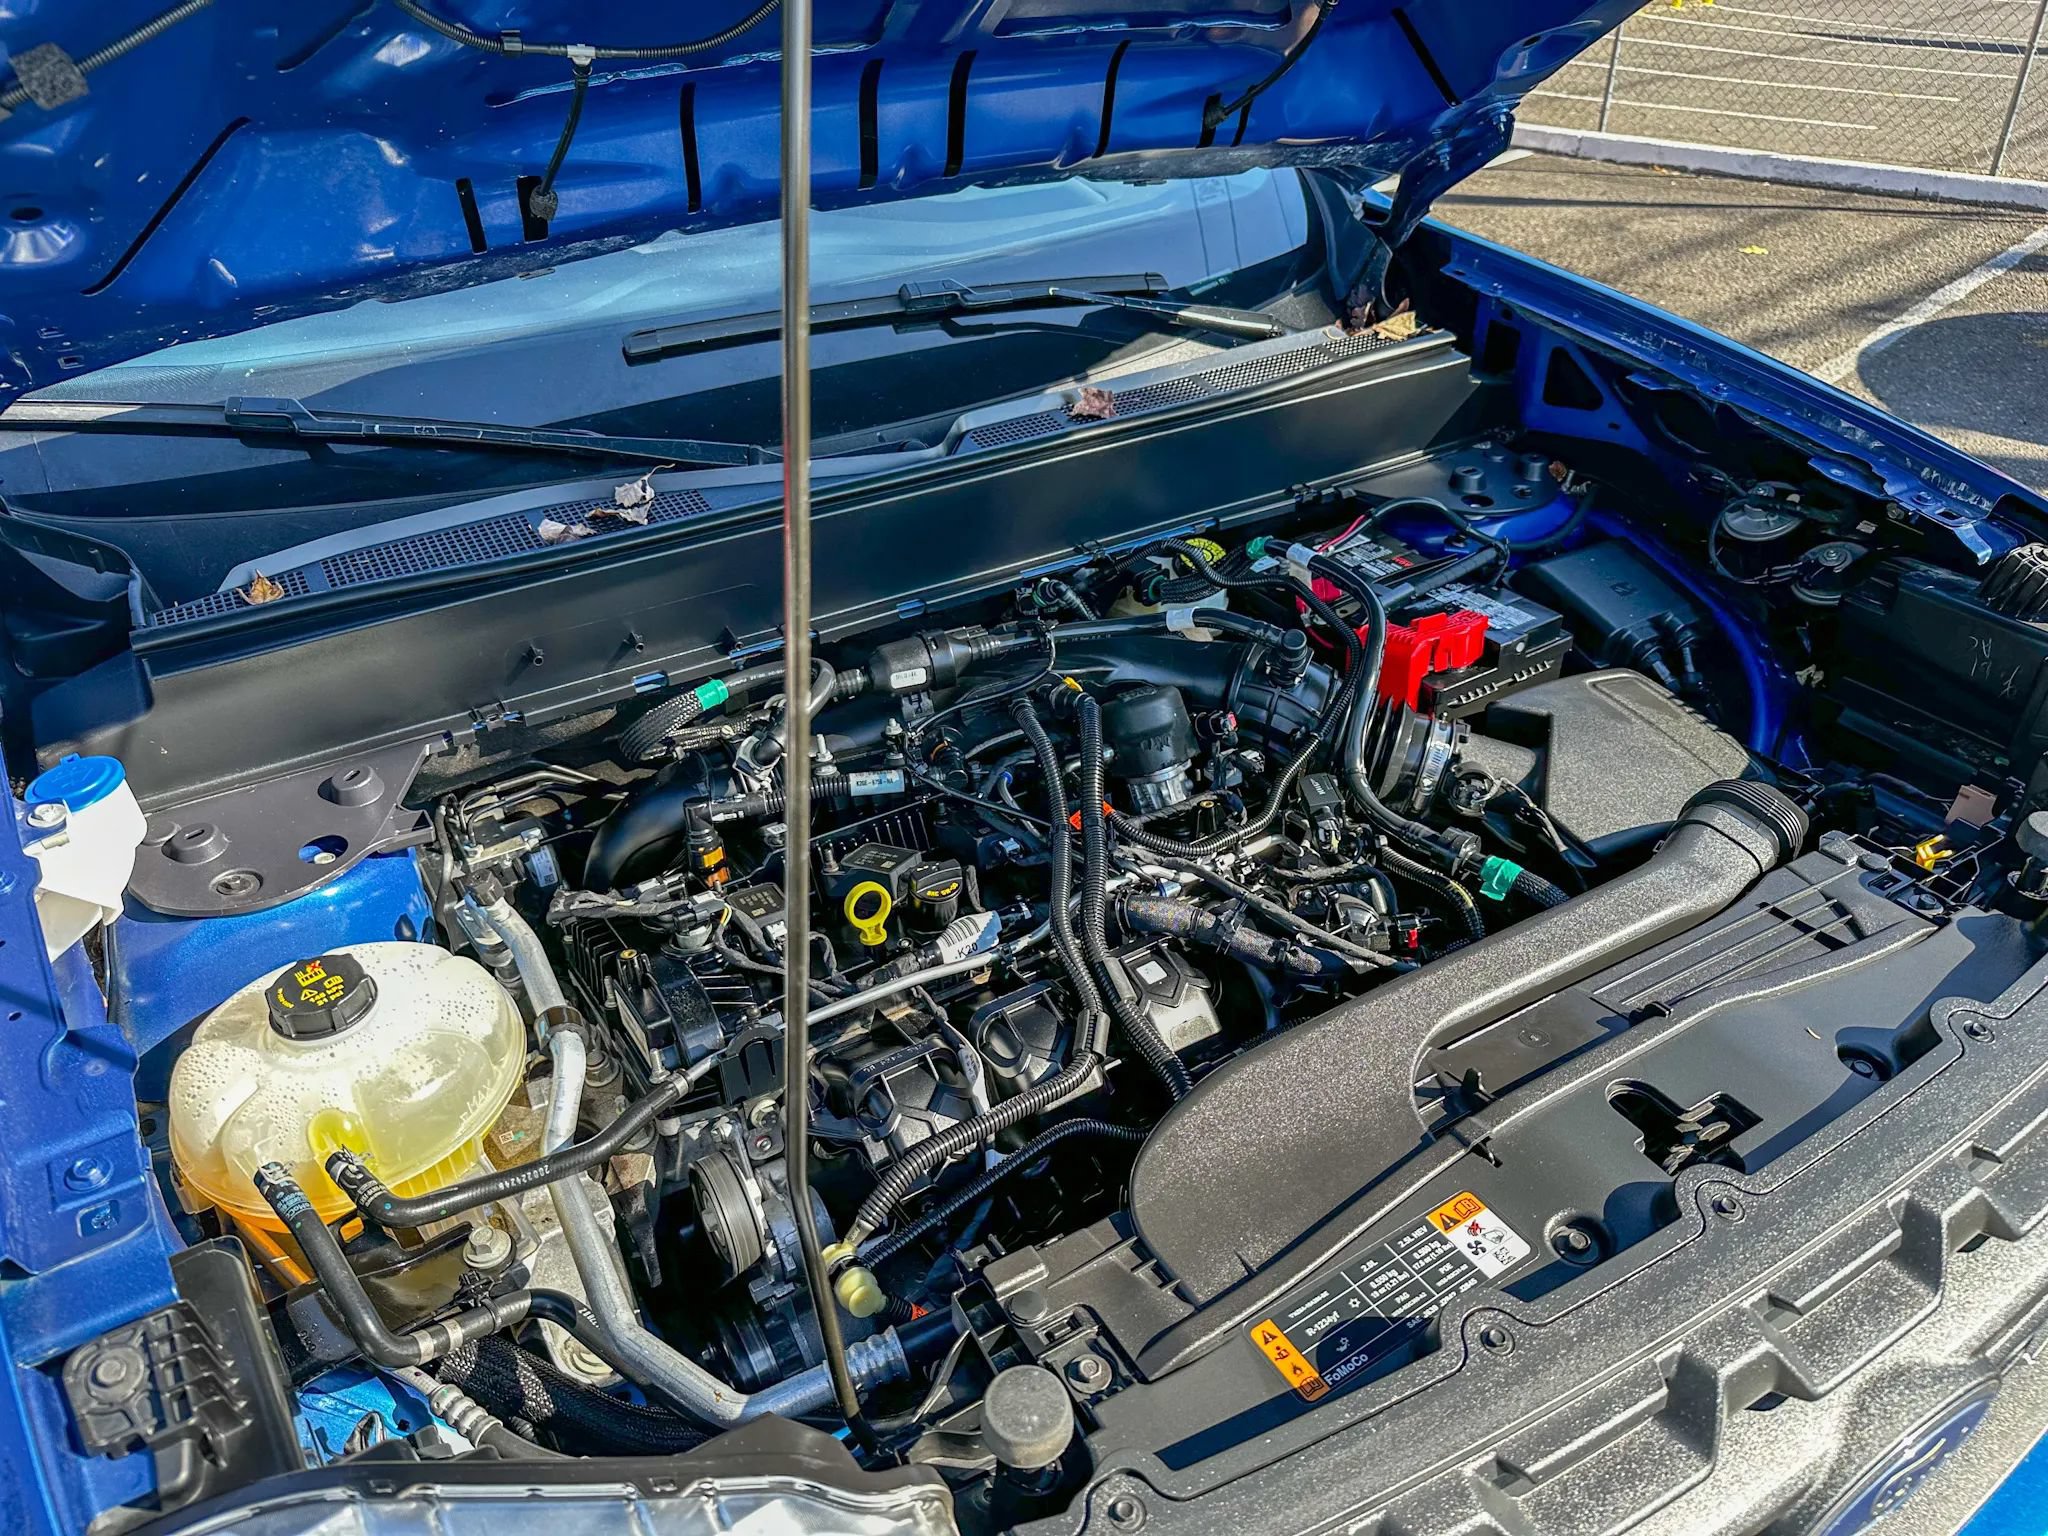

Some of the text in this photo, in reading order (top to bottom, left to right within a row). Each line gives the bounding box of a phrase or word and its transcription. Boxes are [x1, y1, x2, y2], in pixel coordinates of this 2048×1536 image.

[1411, 1225, 1428, 1240] HEV
[1428, 1240, 1442, 1251] kg
[1385, 1268, 1399, 1280] kg
[1394, 1291, 1410, 1304] PAG
[1305, 1310, 1341, 1338] R-1234yf
[1324, 1353, 1369, 1386] FoMoCo
